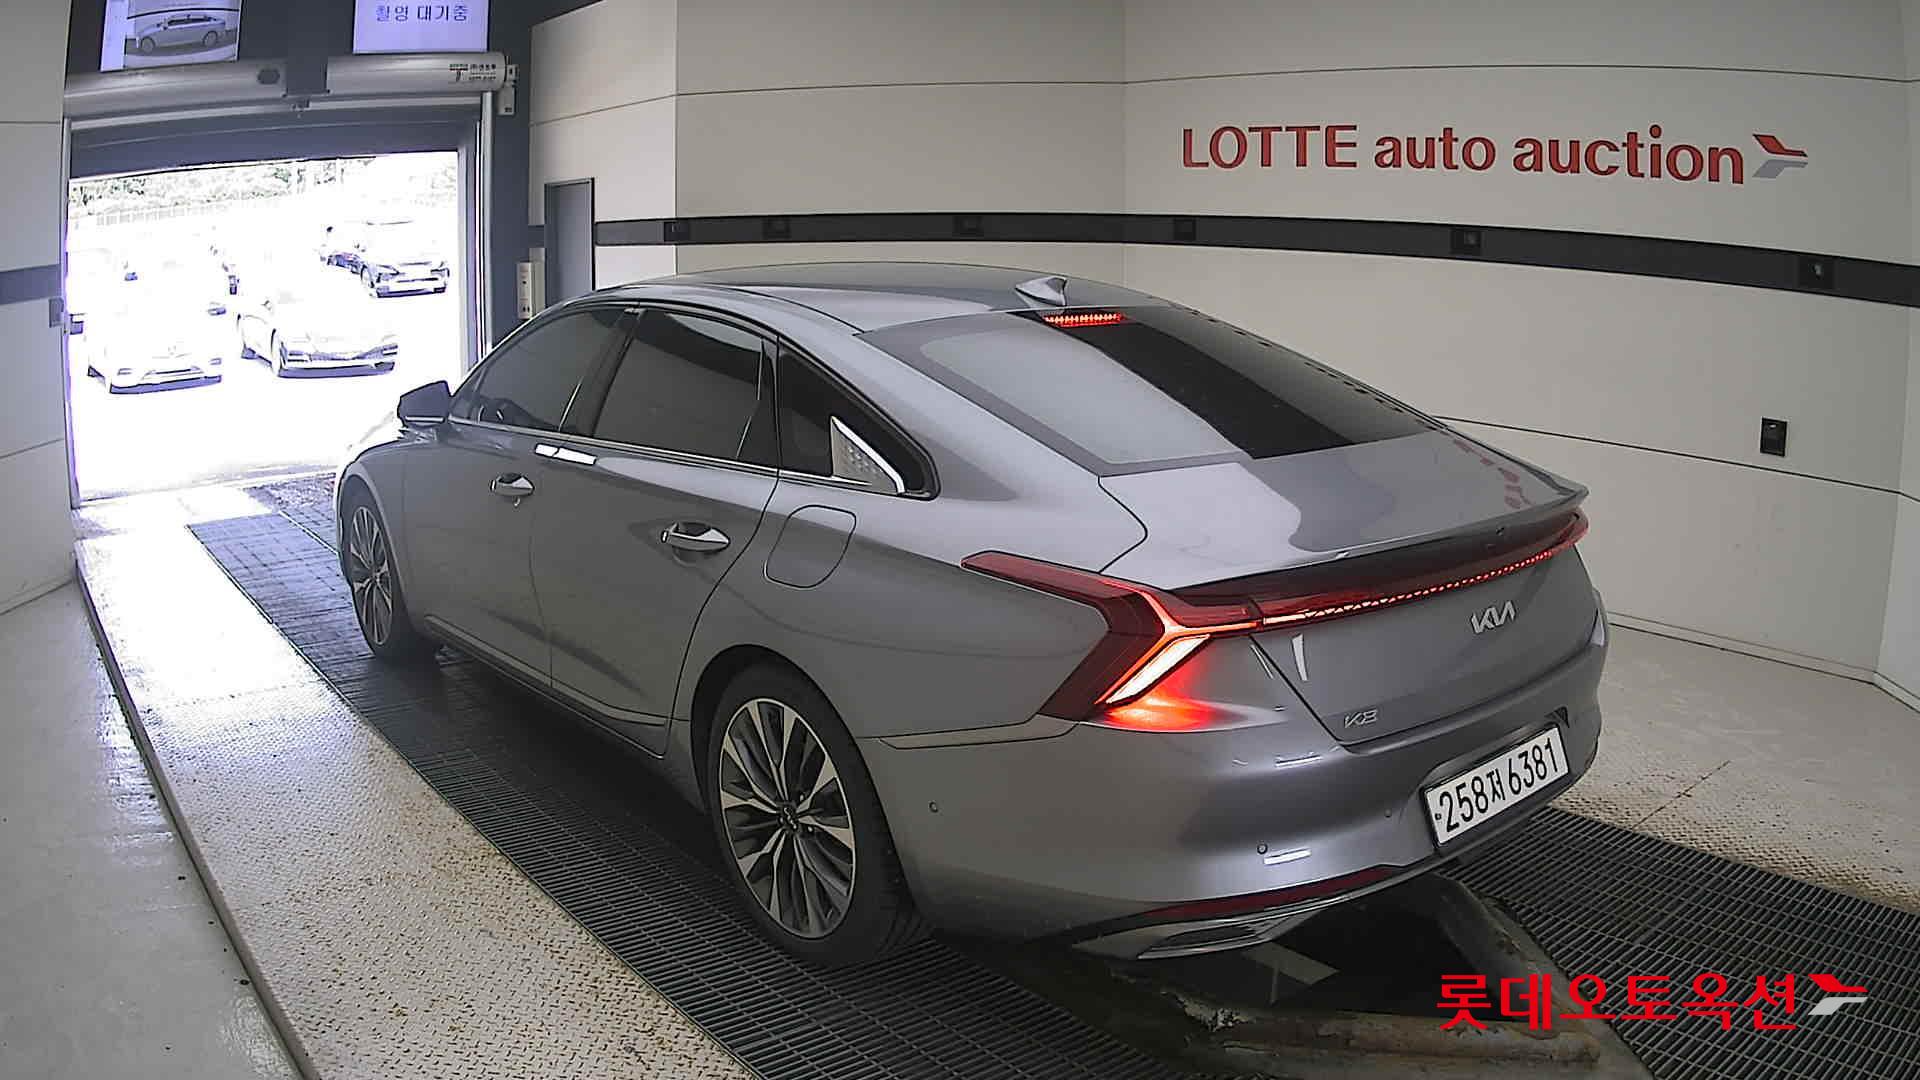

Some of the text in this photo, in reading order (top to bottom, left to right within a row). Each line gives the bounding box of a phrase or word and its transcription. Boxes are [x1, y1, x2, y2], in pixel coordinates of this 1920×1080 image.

[416, 5, 467, 22] 대기중
[1183, 125, 1745, 184] LOTTE auto auction
[1470, 600, 1517, 635] KIA
[1343, 708, 1379, 729] K8
